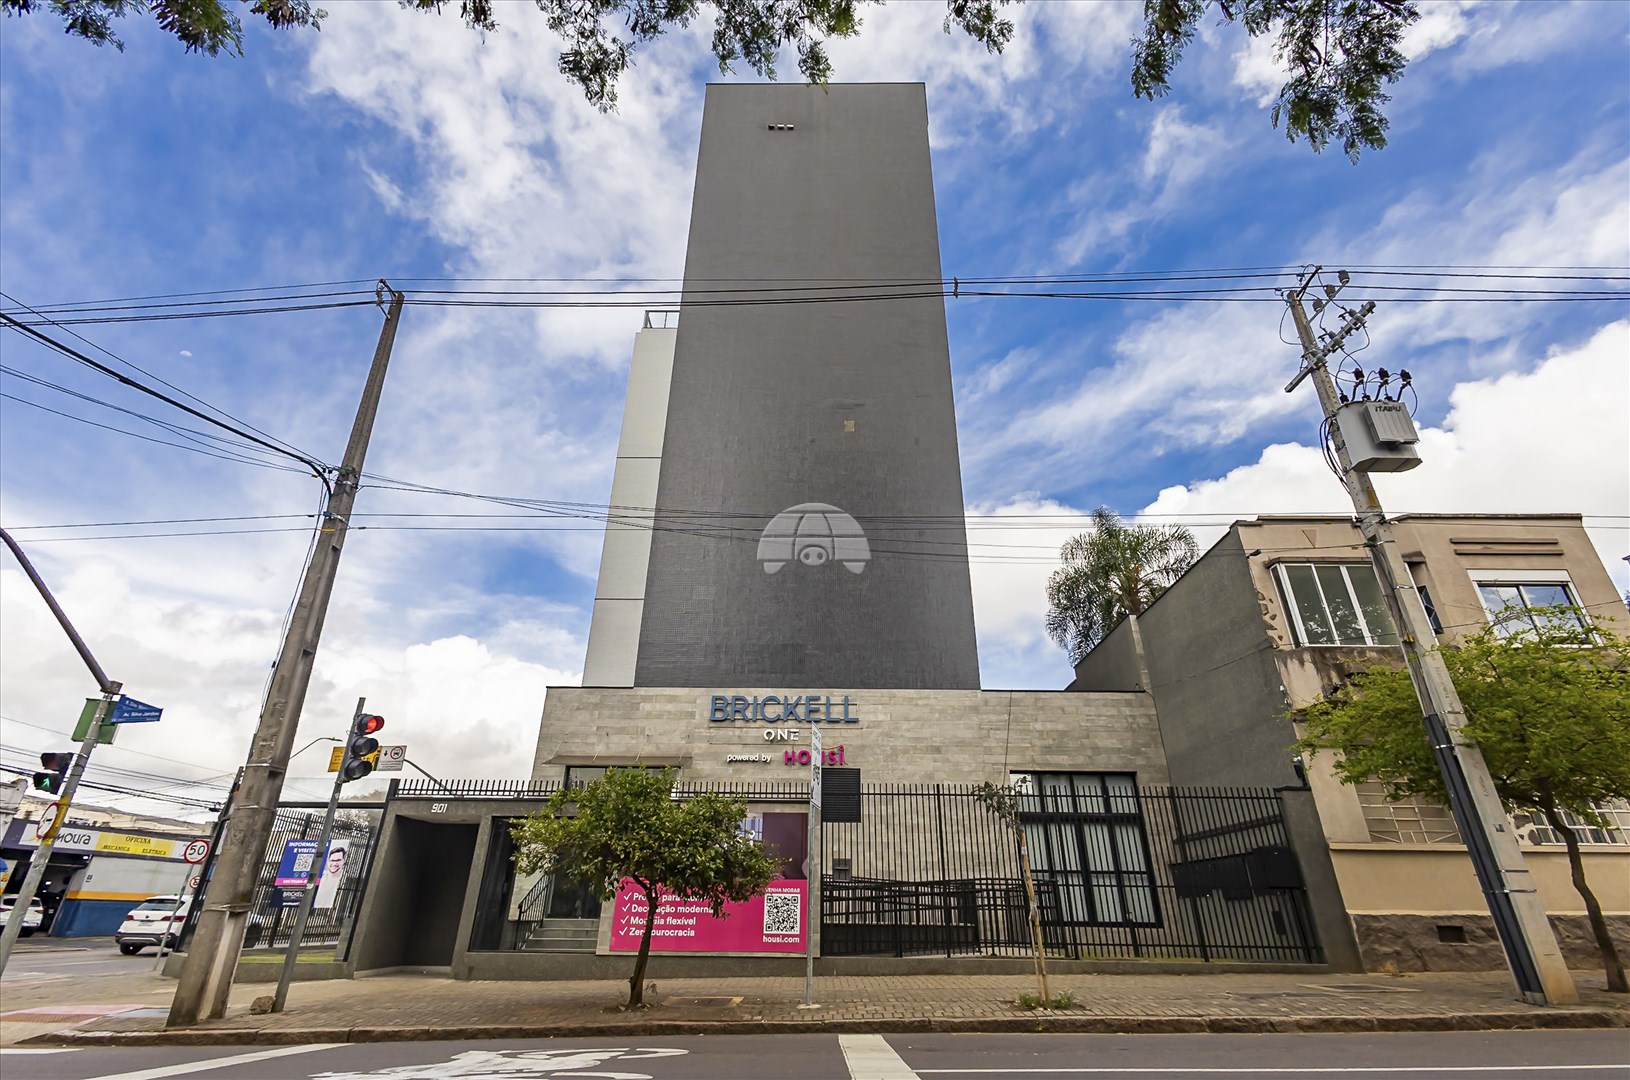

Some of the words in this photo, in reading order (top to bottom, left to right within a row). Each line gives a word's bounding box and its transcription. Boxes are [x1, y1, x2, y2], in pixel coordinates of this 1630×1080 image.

[710, 695, 859, 722] BRICKELL
[763, 728, 800, 741] ONE
[726, 753, 759, 762] powered
[761, 753, 772, 763] by
[431, 803, 448, 813] 901
[125, 835, 151, 844] OFICINA
[188, 844, 206, 856] 50
[661, 894, 681, 902] para
[631, 903, 675, 914] Decação
[677, 904, 714, 913] moderna
[630, 916, 664, 925] Mordia
[666, 916, 696, 925] flexível
[629, 927, 647, 936] Zer
[762, 934, 800, 943] housi.com
